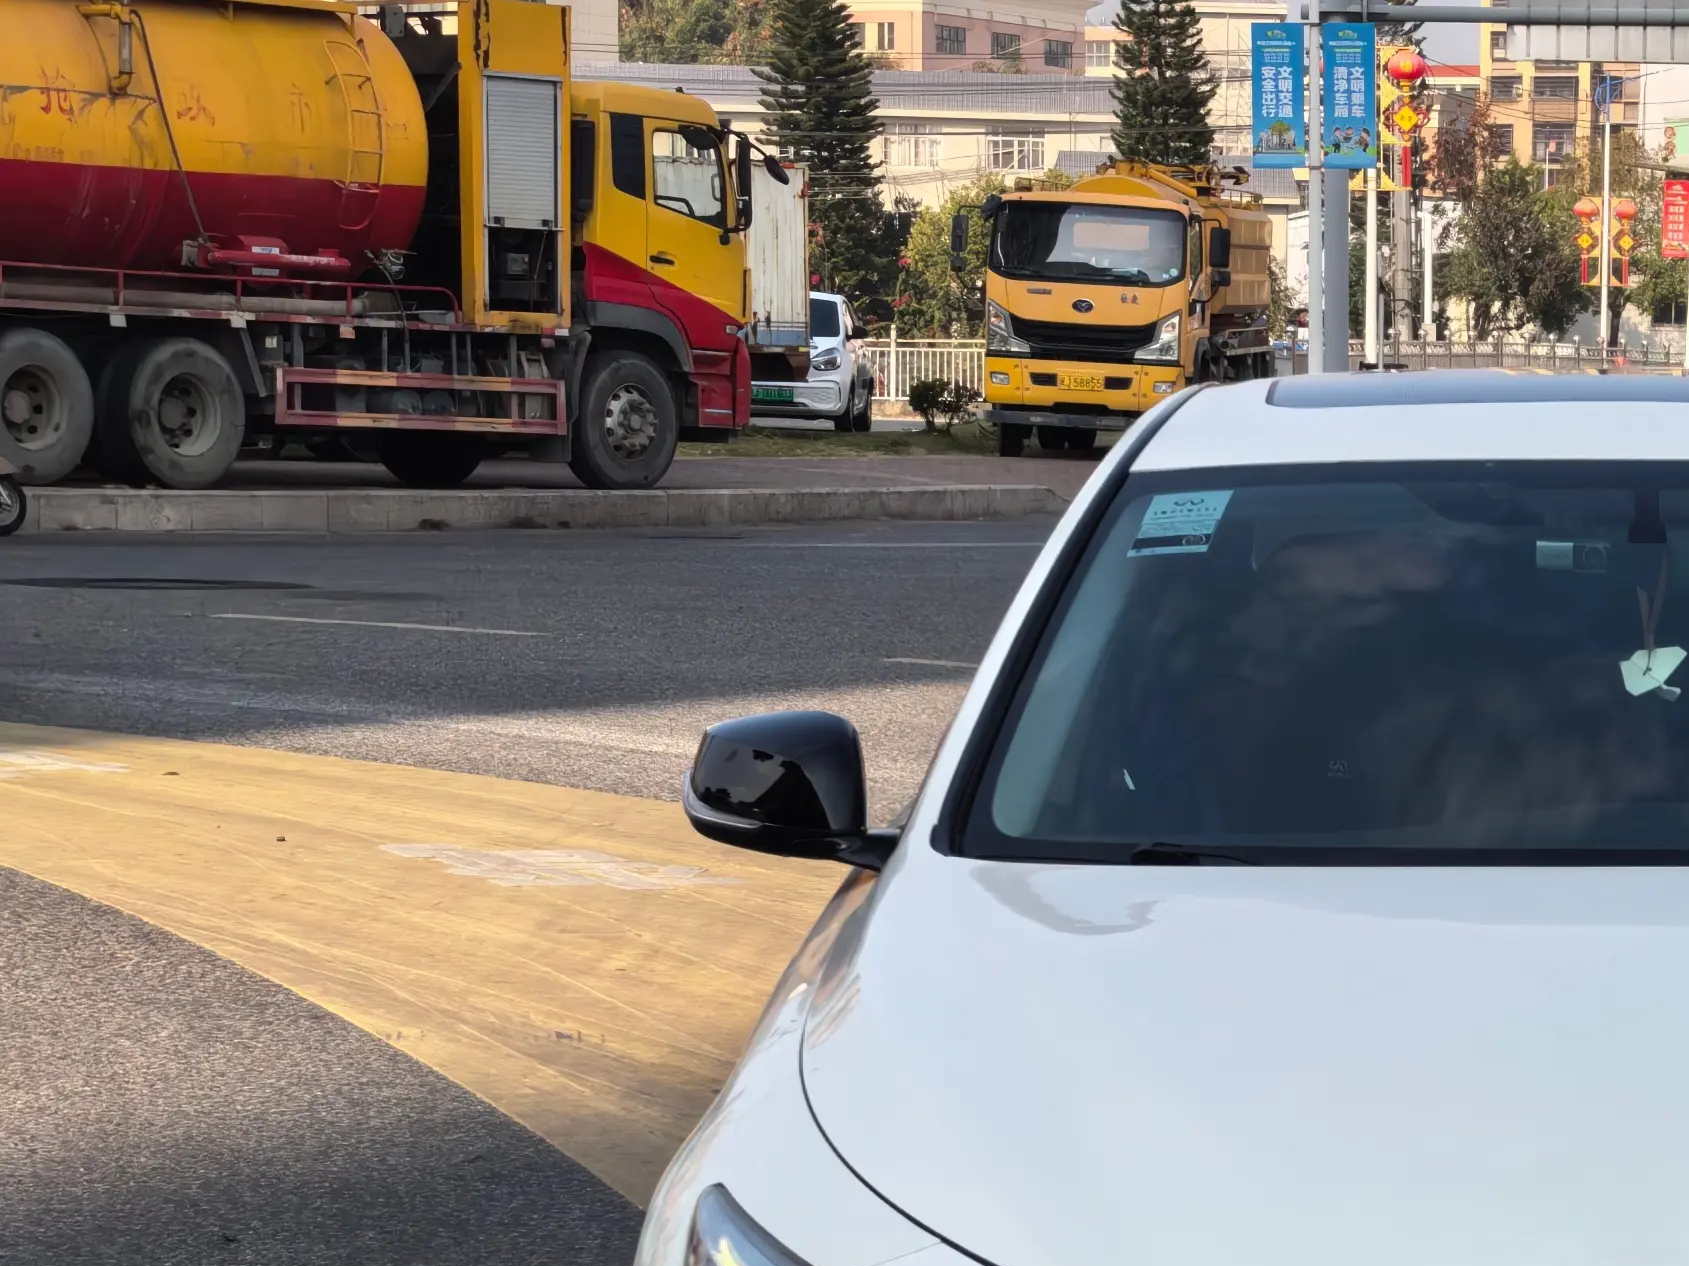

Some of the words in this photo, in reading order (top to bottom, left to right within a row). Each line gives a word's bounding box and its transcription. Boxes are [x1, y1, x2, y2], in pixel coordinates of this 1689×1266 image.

[1261, 66, 1277, 118] 安全出行
[1277, 66, 1293, 118] 文明交通
